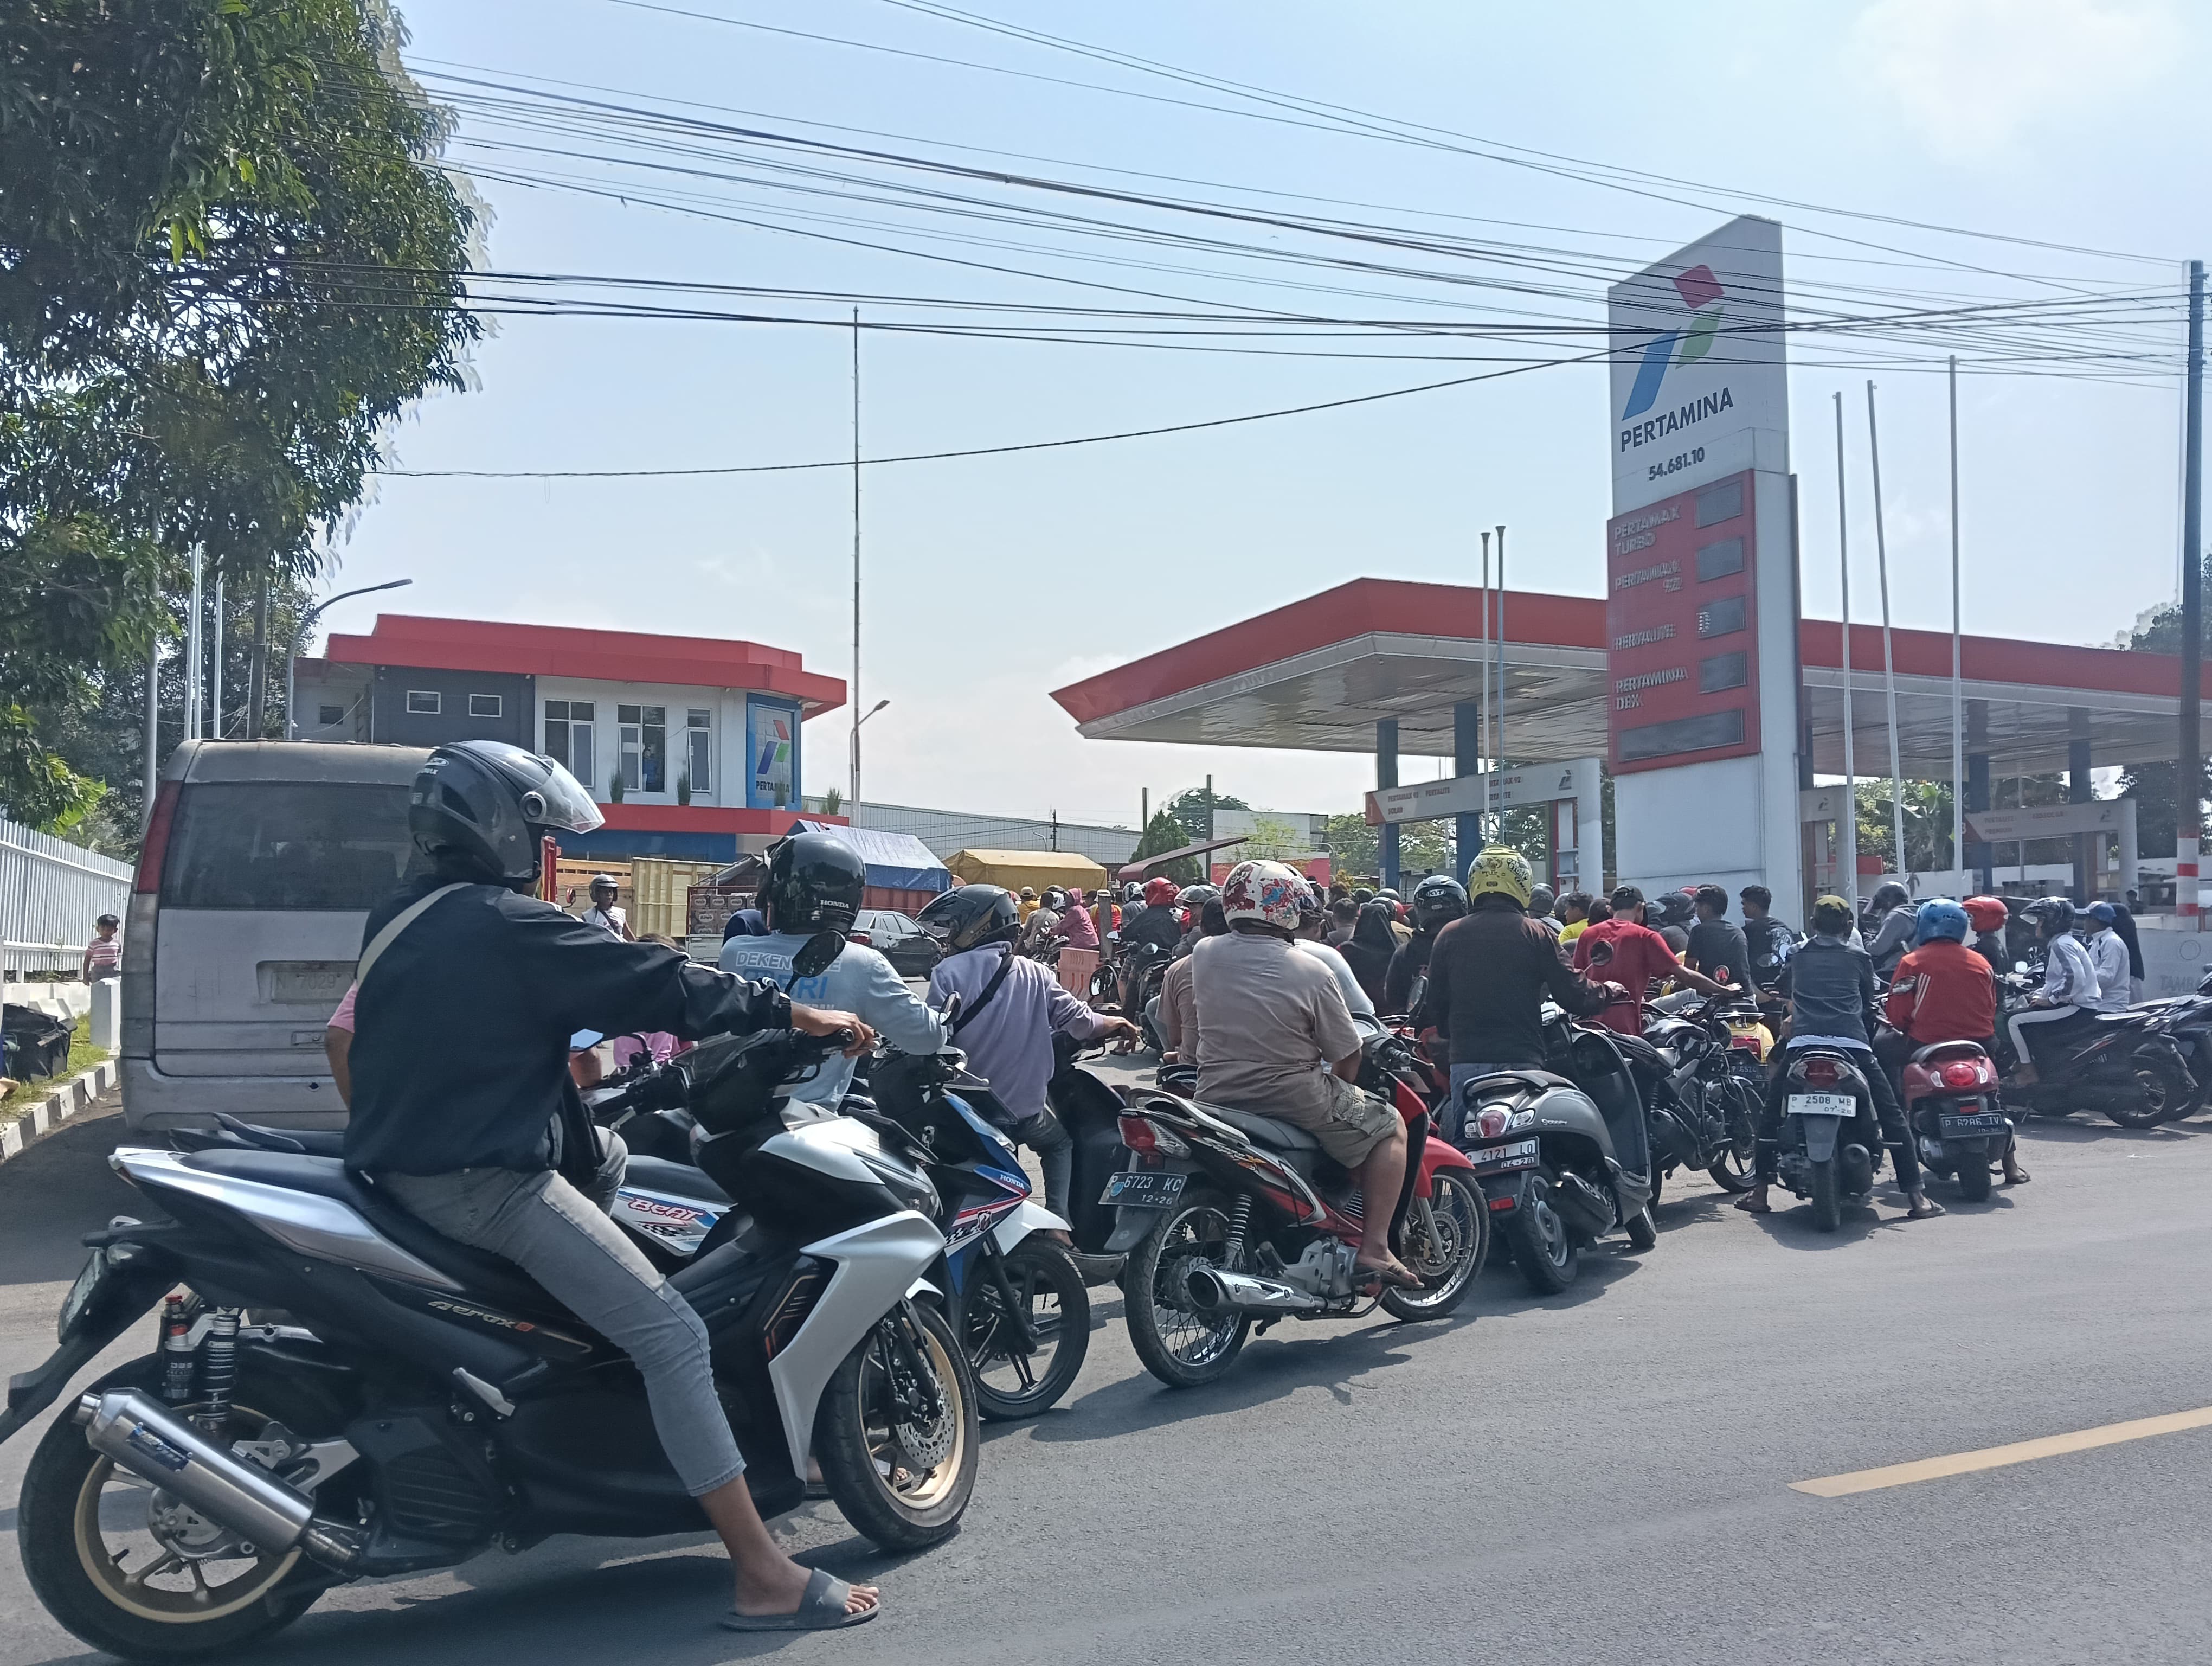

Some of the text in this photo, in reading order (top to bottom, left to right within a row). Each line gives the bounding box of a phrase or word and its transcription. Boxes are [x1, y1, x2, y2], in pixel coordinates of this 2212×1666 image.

[1621, 387, 1734, 452] PERTAMINA
[1648, 447, 1705, 481] 54.681.10
[1614, 505, 1681, 540] PERTAMAX
[1615, 533, 1656, 558] TURBO
[1615, 560, 1680, 591] PERTAMAX
[1613, 667, 1688, 694] PERTAMINA
[1615, 694, 1643, 711] DEX
[820, 900, 850, 909] HONDA
[1806, 1095, 1831, 1104] 2508
[1945, 1119, 1951, 1127] P
[1481, 1148, 1507, 1161] 4121
[1000, 1174, 1025, 1189] HONDA
[1107, 1175, 1182, 1191] P 6723 KC
